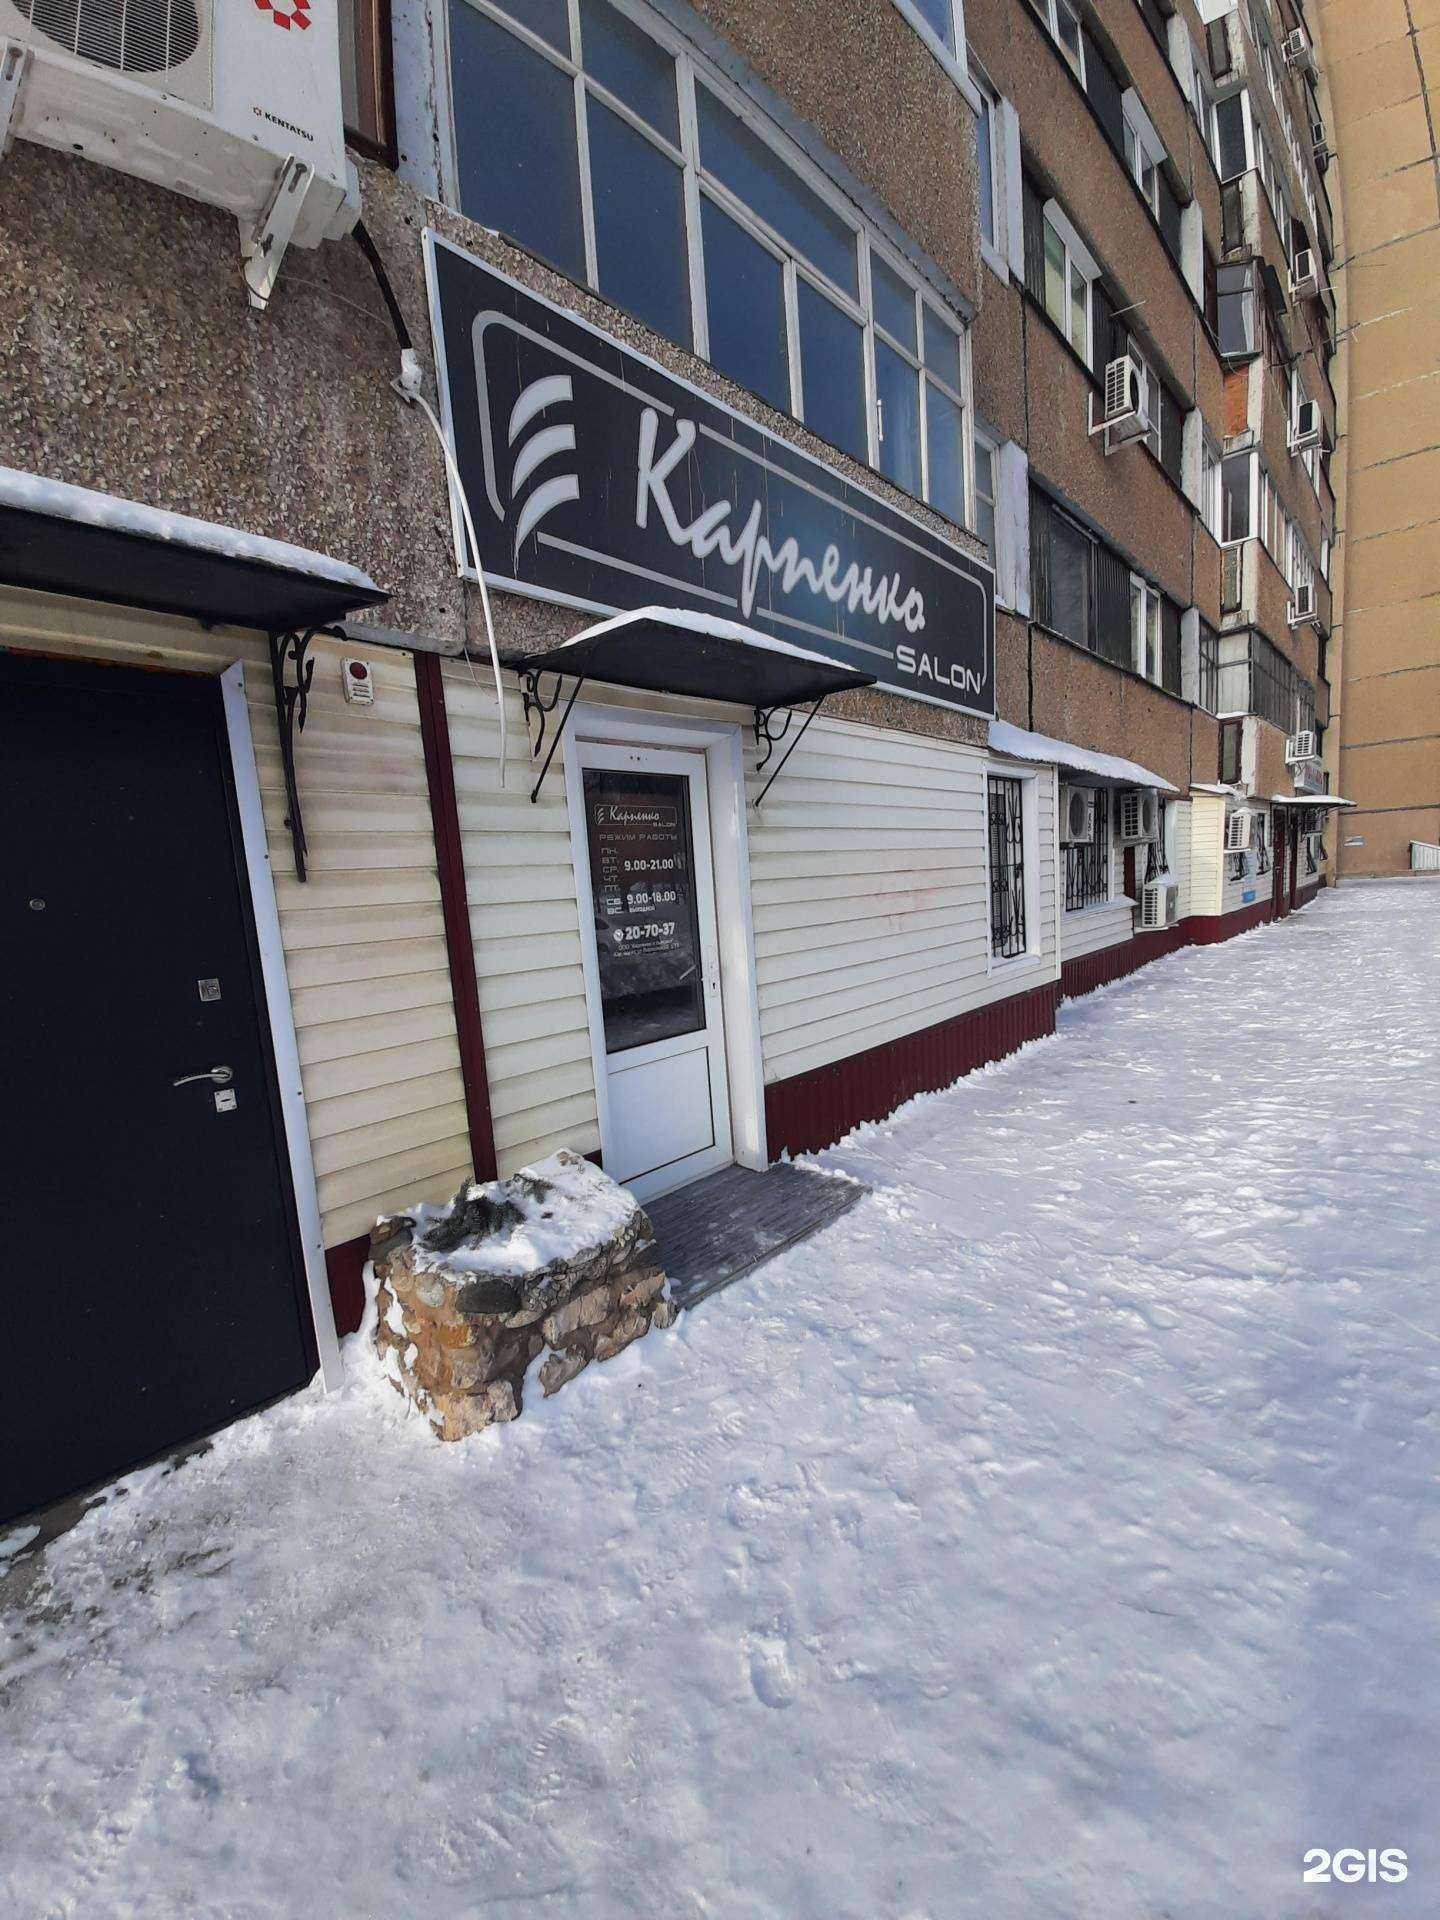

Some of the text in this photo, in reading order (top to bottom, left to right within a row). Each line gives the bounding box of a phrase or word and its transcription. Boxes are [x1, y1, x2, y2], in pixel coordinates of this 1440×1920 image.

[265, 112, 314, 142] KENTATSU
[635, 408, 926, 633] Карпенко
[896, 644, 981, 695] SALON
[609, 806, 660, 826] Карпенко
[599, 833, 678, 841] РЕЖИМ РАБОТЫ
[624, 858, 674, 871] 9.00-21.00
[626, 890, 676, 905] 9.00-18.00
[625, 922, 675, 940] 20-70-37
